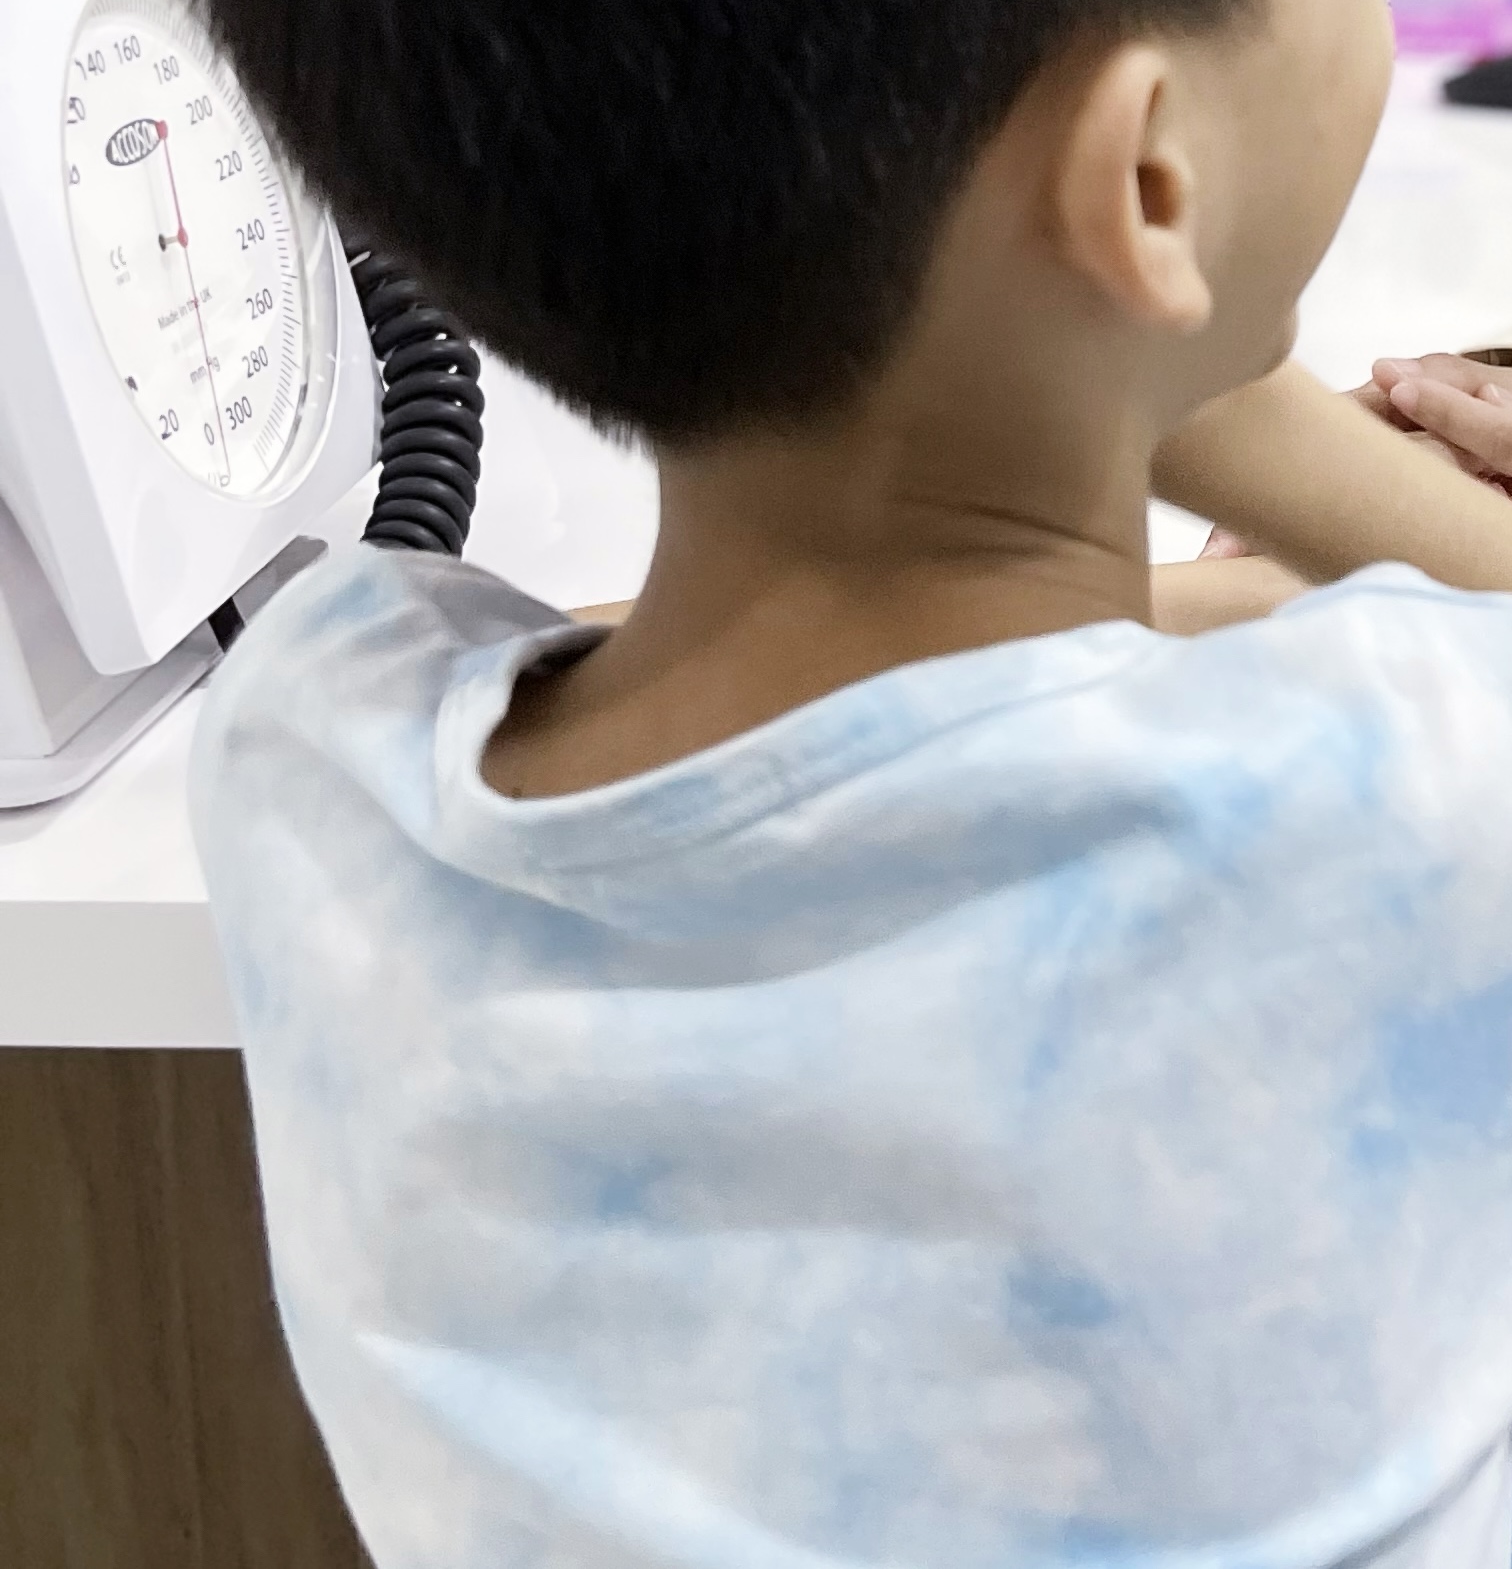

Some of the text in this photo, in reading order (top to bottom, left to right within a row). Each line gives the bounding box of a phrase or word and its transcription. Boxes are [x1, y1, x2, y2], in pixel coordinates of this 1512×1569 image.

[74, 49, 106, 81] 140
[114, 35, 141, 64] 160
[153, 55, 180, 85] 180
[185, 95, 213, 125] 200
[215, 150, 243, 181] 220
[236, 218, 265, 251] 240
[157, 309, 180, 330] Made
[245, 288, 273, 320] 260
[241, 345, 269, 379] 280
[158, 408, 180, 441] 20
[225, 395, 253, 431] 300
[203, 421, 215, 446] 0
